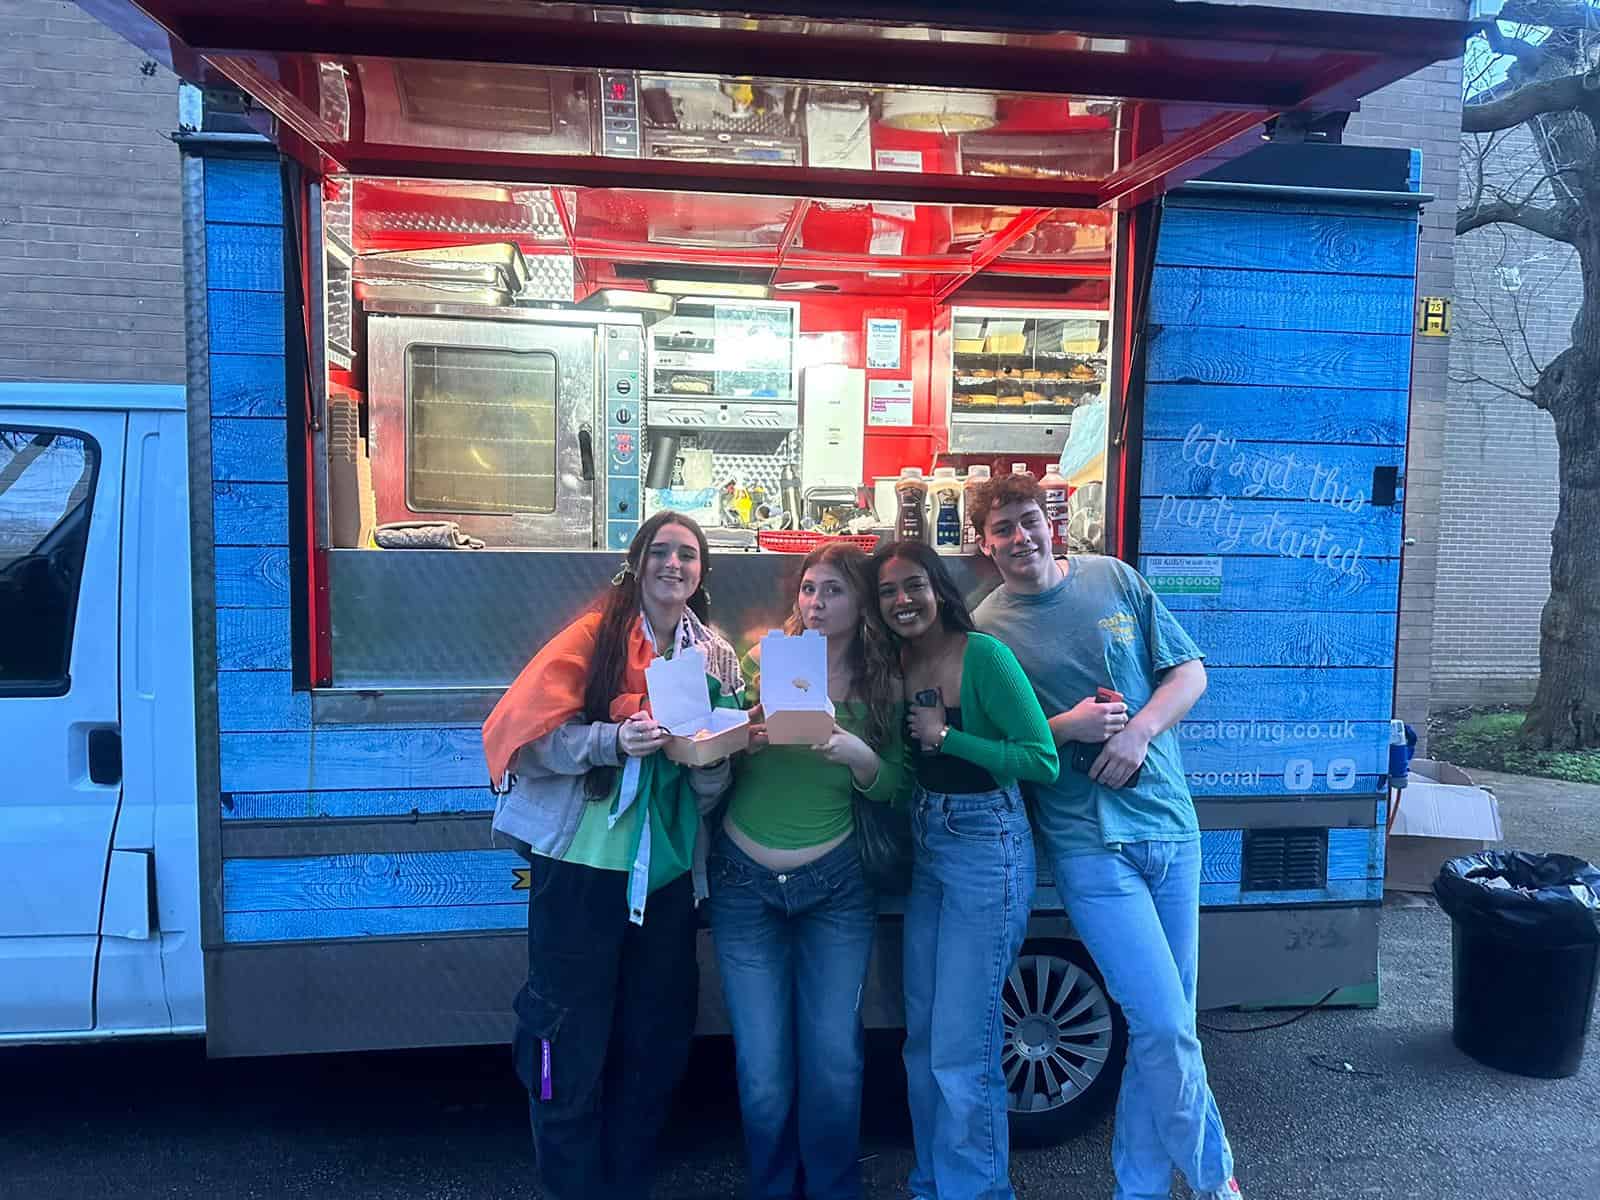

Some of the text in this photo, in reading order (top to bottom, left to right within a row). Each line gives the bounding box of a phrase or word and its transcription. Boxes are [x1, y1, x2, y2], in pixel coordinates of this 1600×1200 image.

[1424, 301, 1446, 331] H
[1430, 303, 1441, 312] 75
[1182, 423, 1364, 513] let's get this
[1153, 493, 1363, 577] party started
[1191, 765, 1260, 786] social
